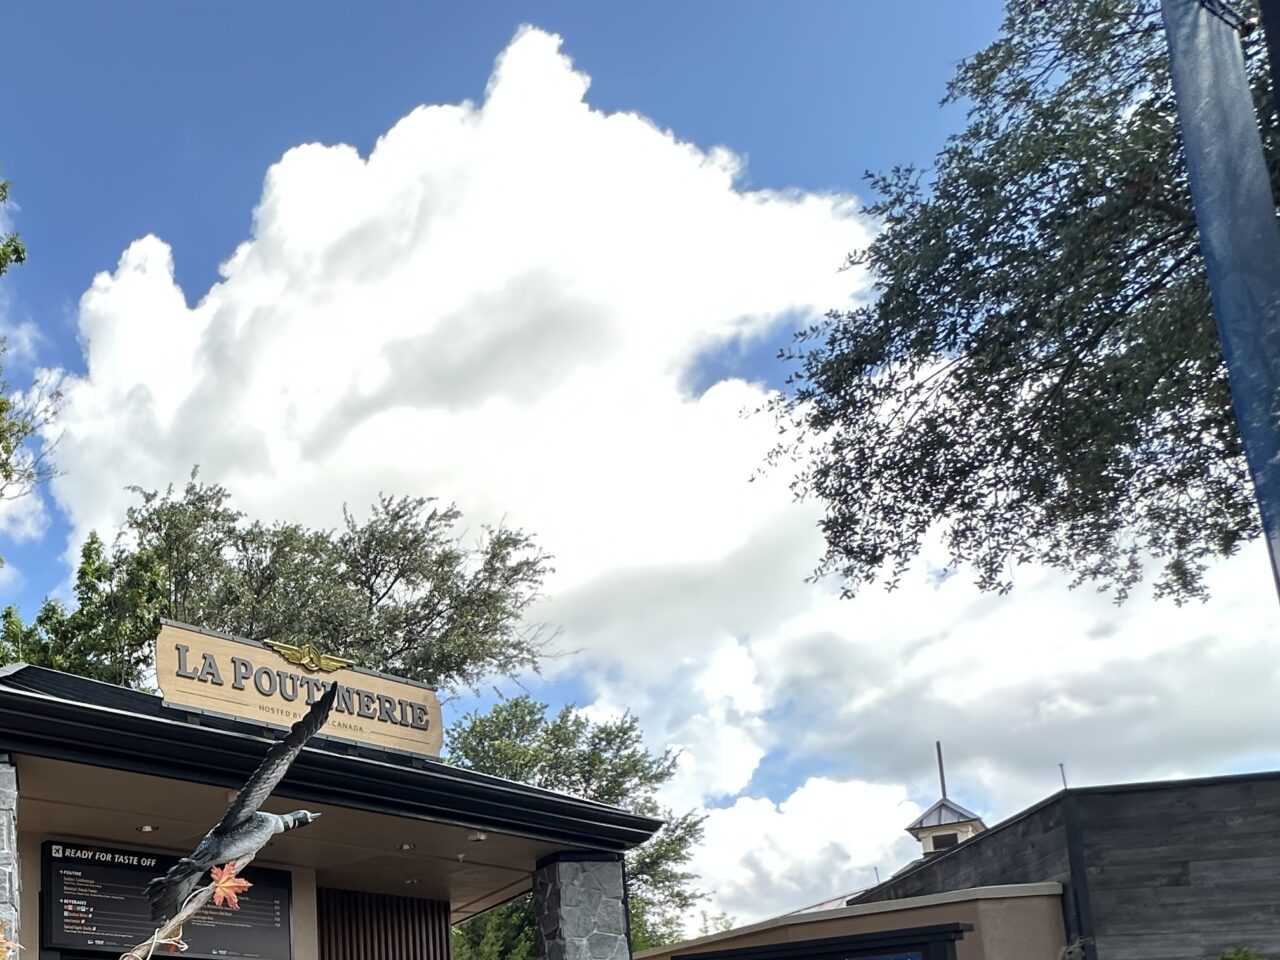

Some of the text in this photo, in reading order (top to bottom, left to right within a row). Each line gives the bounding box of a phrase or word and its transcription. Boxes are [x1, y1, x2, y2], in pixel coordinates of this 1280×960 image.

[176, 644, 224, 685] LA
[258, 704, 291, 717] HOSTED
[331, 720, 364, 732] CANADA
[65, 848, 156, 867] READY FOR TASTE OFF
